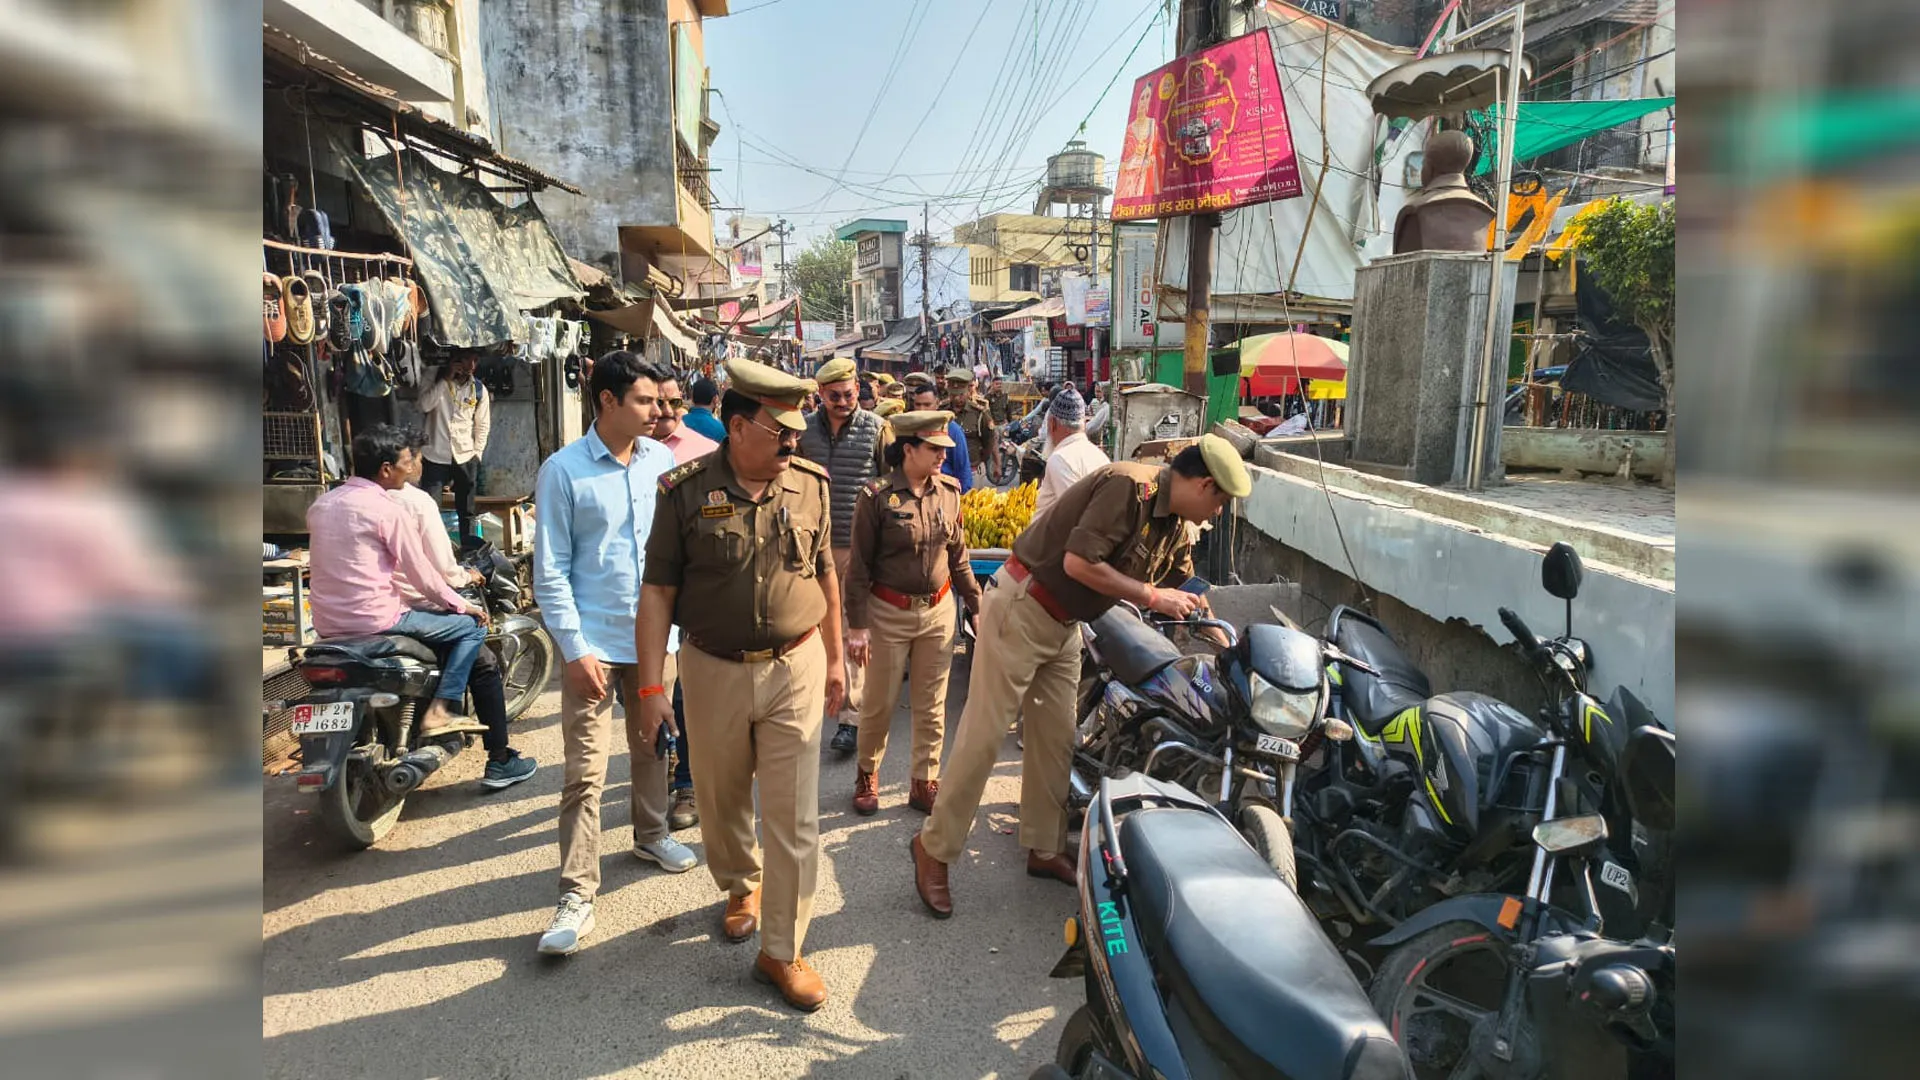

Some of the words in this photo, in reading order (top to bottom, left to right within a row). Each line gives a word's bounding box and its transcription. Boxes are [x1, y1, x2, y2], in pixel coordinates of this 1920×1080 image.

[1246, 103, 1275, 117] KISNA
[315, 718, 348, 730] 1682
[1098, 900, 1129, 957] KITE
